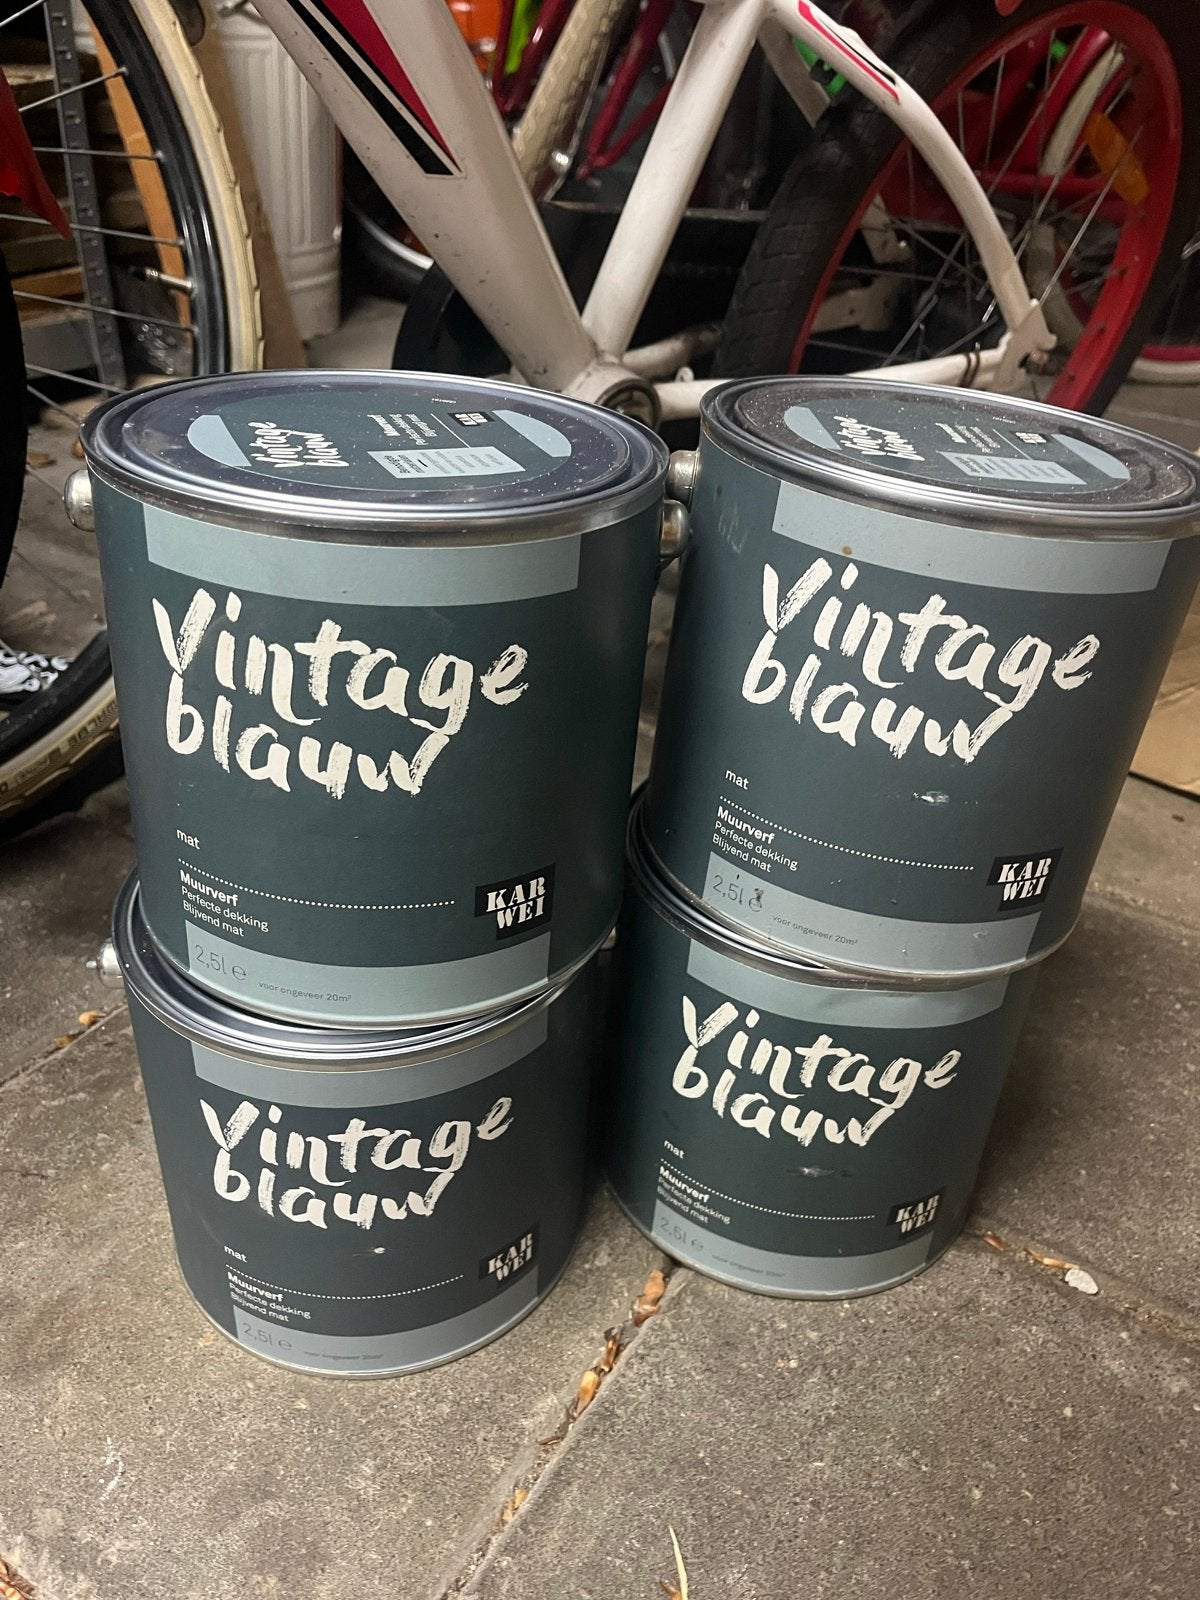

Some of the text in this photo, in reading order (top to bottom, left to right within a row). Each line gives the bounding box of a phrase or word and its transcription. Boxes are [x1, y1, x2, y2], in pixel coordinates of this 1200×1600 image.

[762, 557, 1100, 712] Vintage
[152, 588, 529, 736] Vintage
[742, 630, 1013, 764] blauw
[165, 672, 450, 799] blauw
[725, 769, 749, 790] mat
[176, 829, 200, 850] mat
[717, 805, 775, 844] Muurverf
[712, 833, 772, 873] Blijvend mat
[715, 820, 799, 871] Perfecte dekking
[180, 869, 239, 907] Muurverf
[997, 858, 1052, 883] KAR
[1003, 877, 1047, 901] WEI
[181, 885, 269, 933] Perfecte dekking
[486, 876, 546, 912] KAR
[497, 896, 545, 929] WEI
[183, 899, 245, 937] Blijvend mat
[772, 914, 791, 927] voor
[793, 922, 833, 940] ongeveer
[258, 982, 278, 992] voor
[280, 987, 324, 998] ongeveer
[682, 995, 962, 1109] Vintage
[672, 1045, 896, 1147] blauw
[200, 1097, 514, 1186] Vintage
[664, 1140, 685, 1159] mat
[213, 1147, 455, 1230] blauw
[659, 1166, 710, 1203] Muurverf
[896, 1195, 939, 1223] KAR
[901, 1207, 937, 1233] WEI
[224, 1245, 248, 1263] mat
[488, 1233, 533, 1274] KAR
[496, 1245, 533, 1281] WEI
[227, 1271, 284, 1302] Muurverf
[229, 1282, 312, 1320] Perfecte dekking
[268, 1310, 290, 1322] mat
